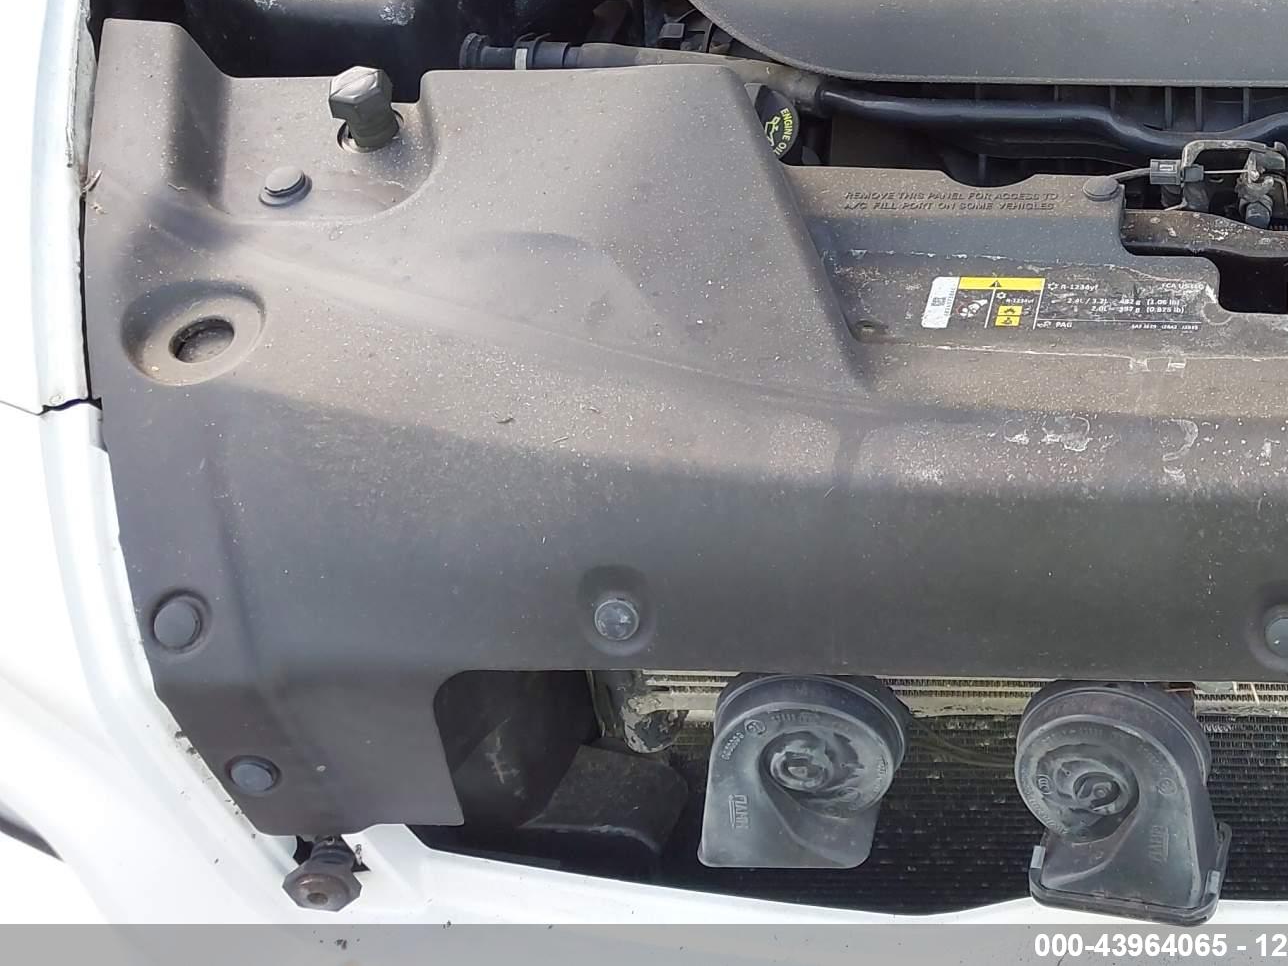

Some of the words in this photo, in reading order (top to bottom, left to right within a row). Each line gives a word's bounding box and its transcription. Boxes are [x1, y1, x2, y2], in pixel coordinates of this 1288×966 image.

[780, 108, 793, 141] ENGINE
[773, 142, 787, 155] OIL
[844, 192, 895, 200] REMOVE
[898, 192, 925, 200] THIS
[927, 192, 965, 200] PANEL
[967, 192, 992, 200] FOR
[994, 193, 1040, 201] ACCESS
[1042, 193, 1059, 201] TO
[844, 202, 868, 210] A/C
[873, 202, 897, 210] FILL
[902, 202, 934, 210] PORT
[999, 203, 1055, 211] VEHICLES
